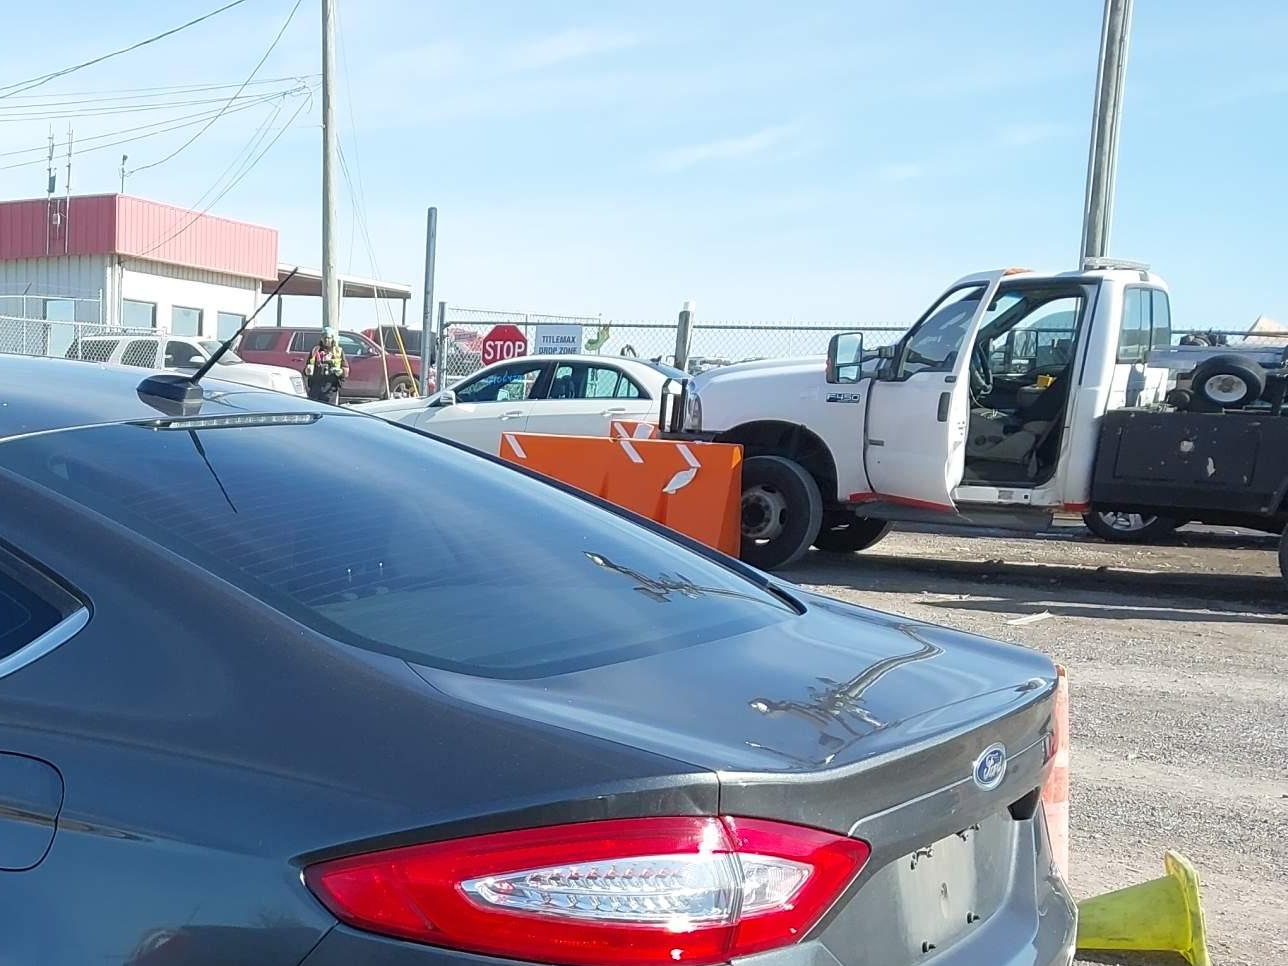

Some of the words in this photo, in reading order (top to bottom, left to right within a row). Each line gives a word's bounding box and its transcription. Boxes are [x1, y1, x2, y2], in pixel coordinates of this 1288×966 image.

[541, 335, 577, 344] TITLEMAX
[484, 340, 525, 359] STOP
[538, 346, 558, 355] DROP
[559, 346, 578, 355] ZONE
